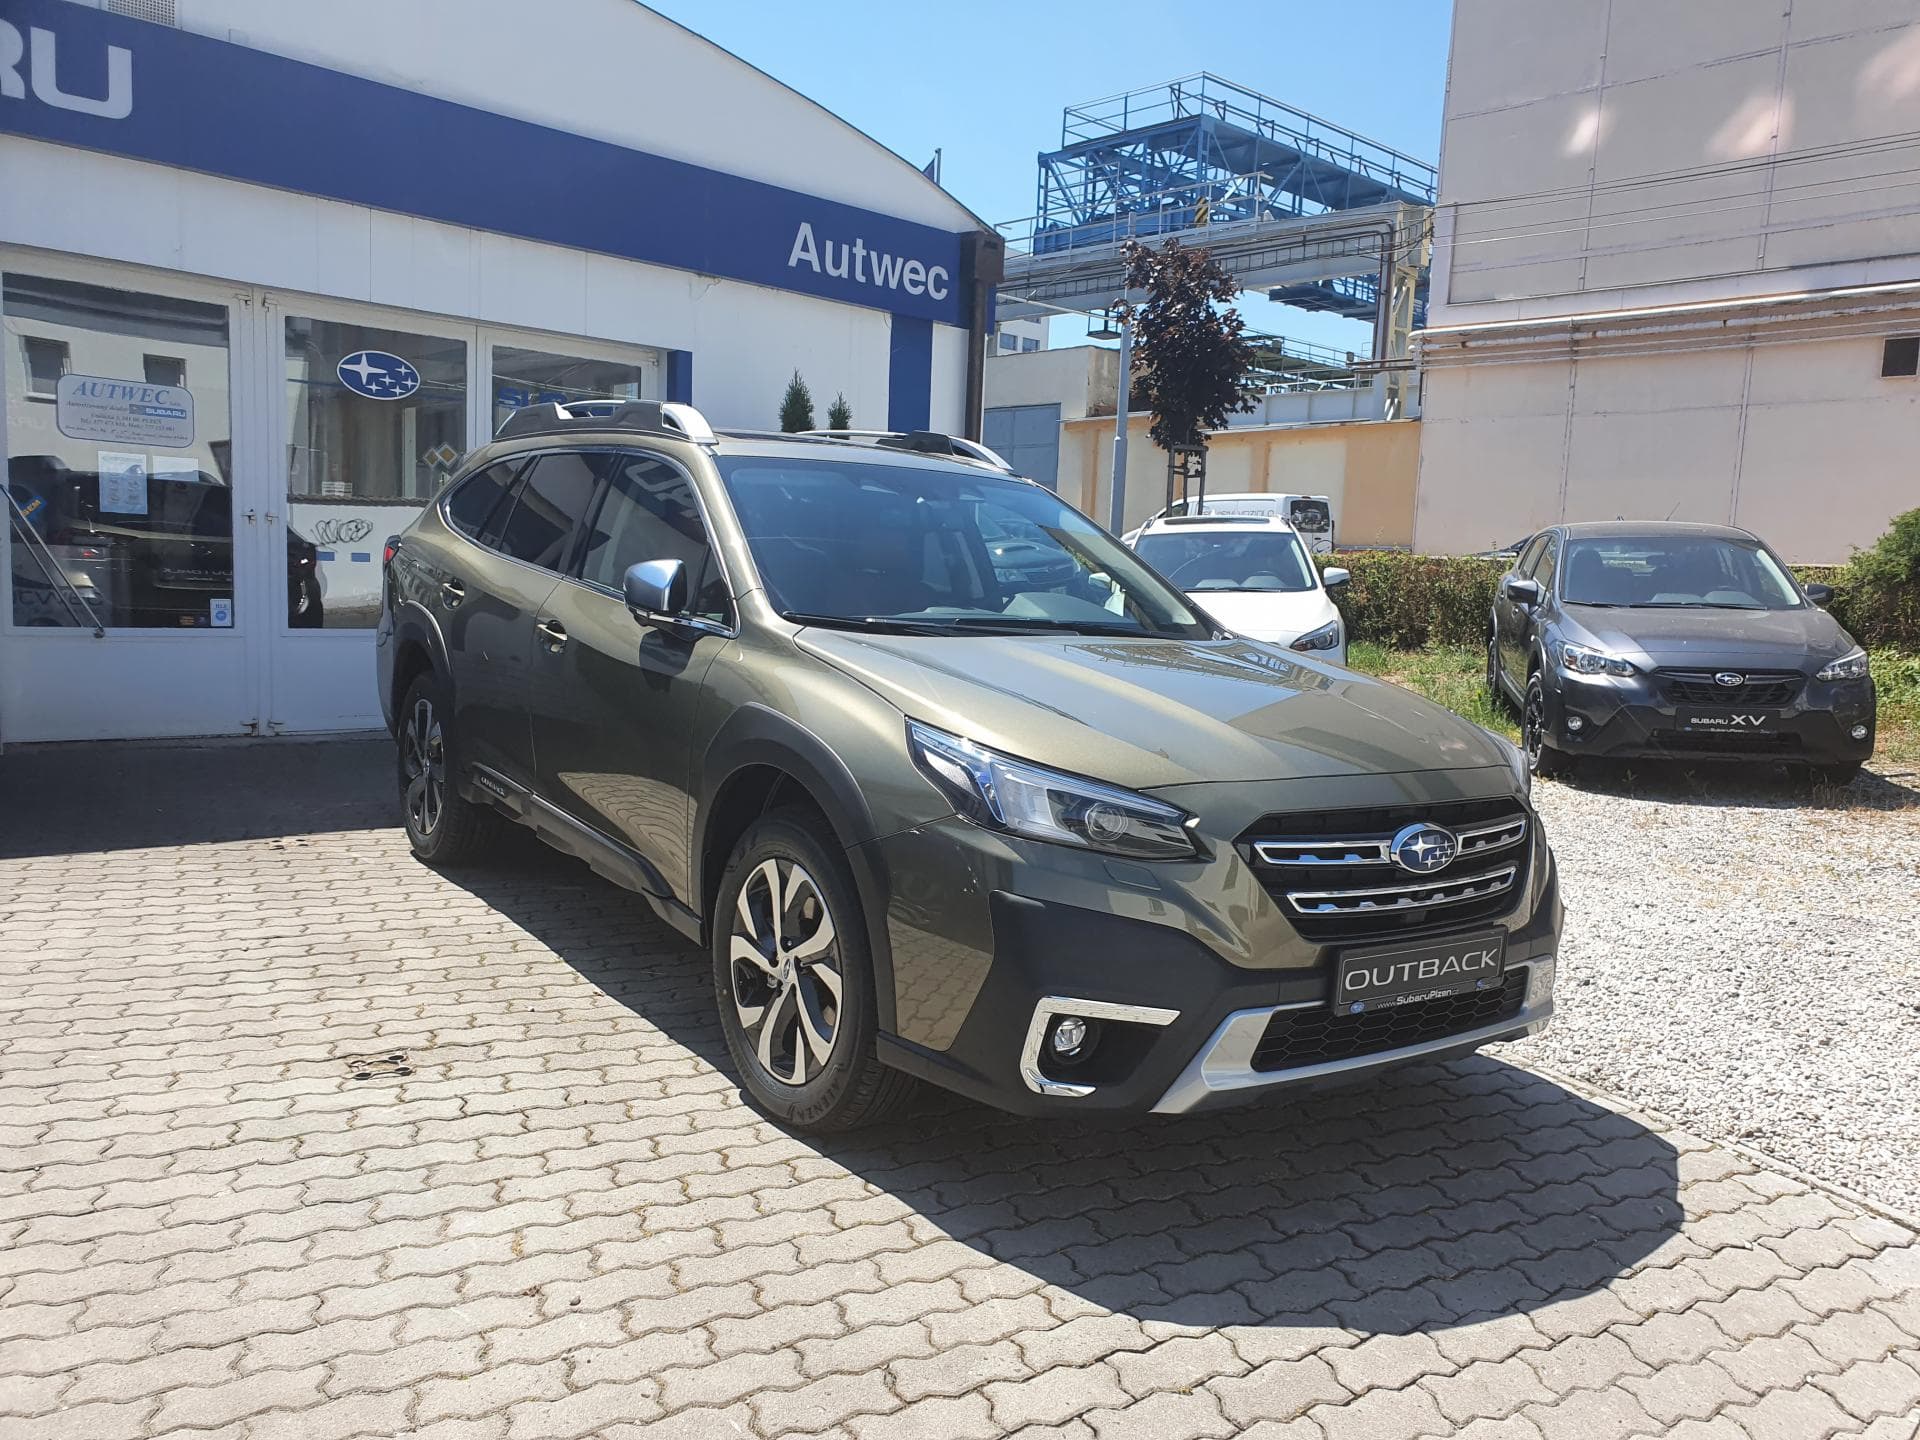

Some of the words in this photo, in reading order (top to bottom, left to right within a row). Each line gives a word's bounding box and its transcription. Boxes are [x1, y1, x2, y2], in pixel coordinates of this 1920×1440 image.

[0, 18, 133, 120] U
[788, 222, 949, 300] Autwec
[72, 380, 170, 405] AUTWEC
[145, 407, 186, 418] SUBARU
[1690, 717, 1728, 725] SUBARU
[1730, 714, 1766, 726] XV
[1345, 948, 1498, 991] OUTBACK
